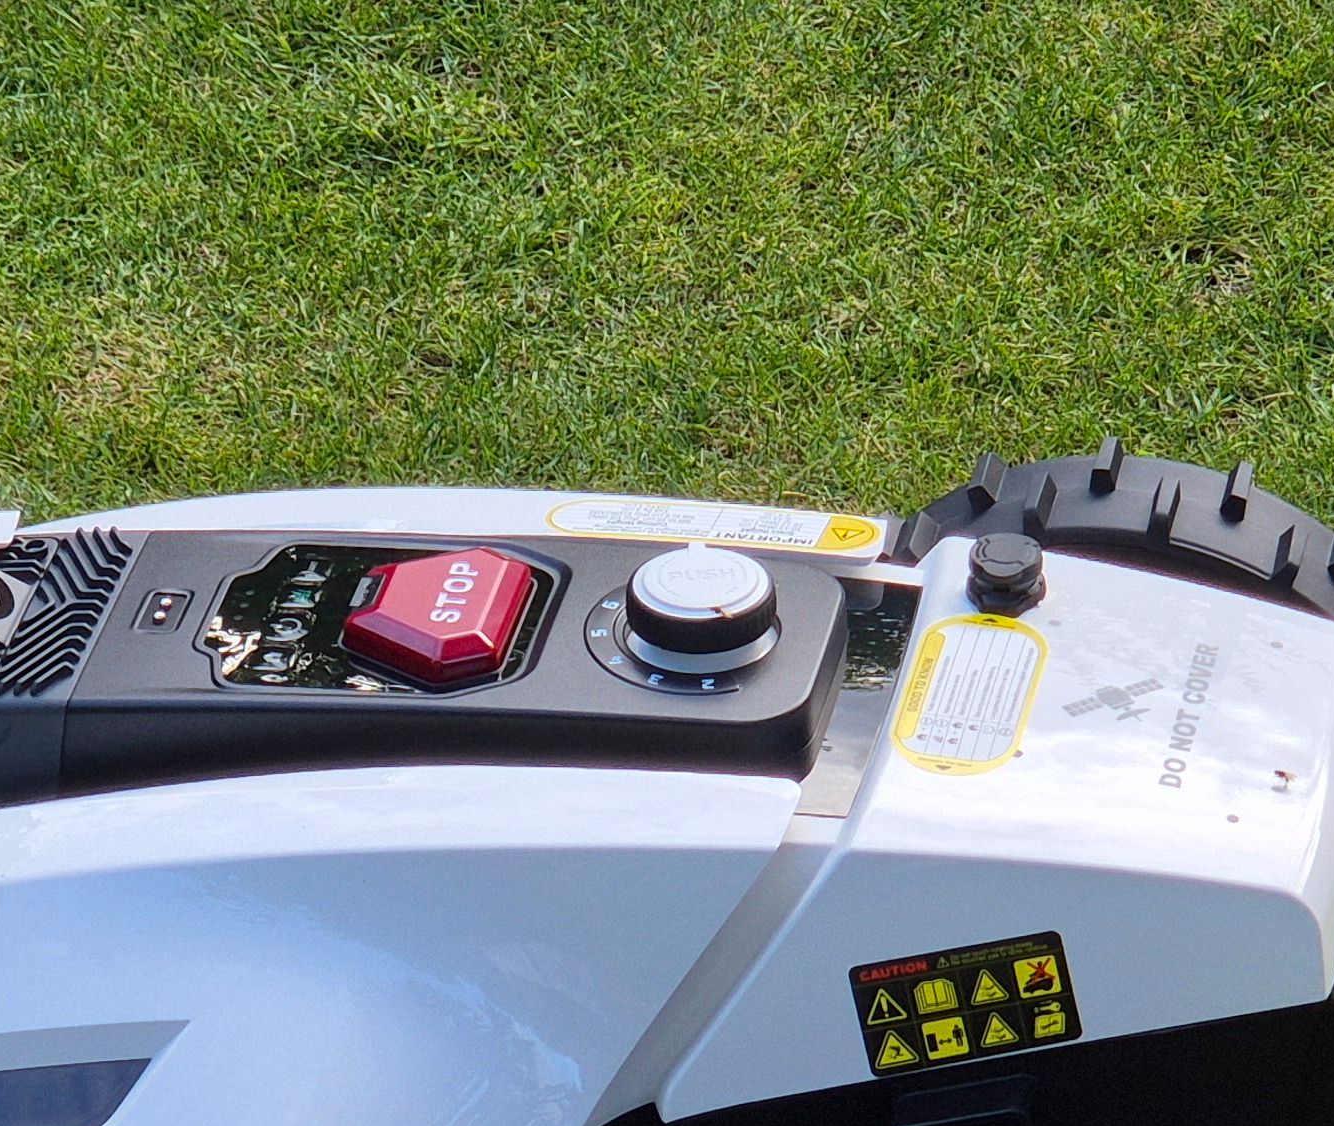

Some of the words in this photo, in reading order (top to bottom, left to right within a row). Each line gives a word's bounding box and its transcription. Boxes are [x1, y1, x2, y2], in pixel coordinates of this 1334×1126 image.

[713, 531, 813, 546] IMPORTANT
[429, 561, 479, 624] STOP
[601, 600, 620, 610] 6
[590, 628, 608, 638] 5
[647, 673, 664, 686] 3
[919, 656, 934, 681] KNOW
[1182, 643, 1220, 705] COVER
[701, 678, 715, 690] 2
[914, 678, 927, 691] TO
[907, 689, 923, 712] GOOD
[1168, 708, 1201, 753] NOT
[1158, 757, 1187, 789] DO
[858, 960, 929, 982] CAUTION
